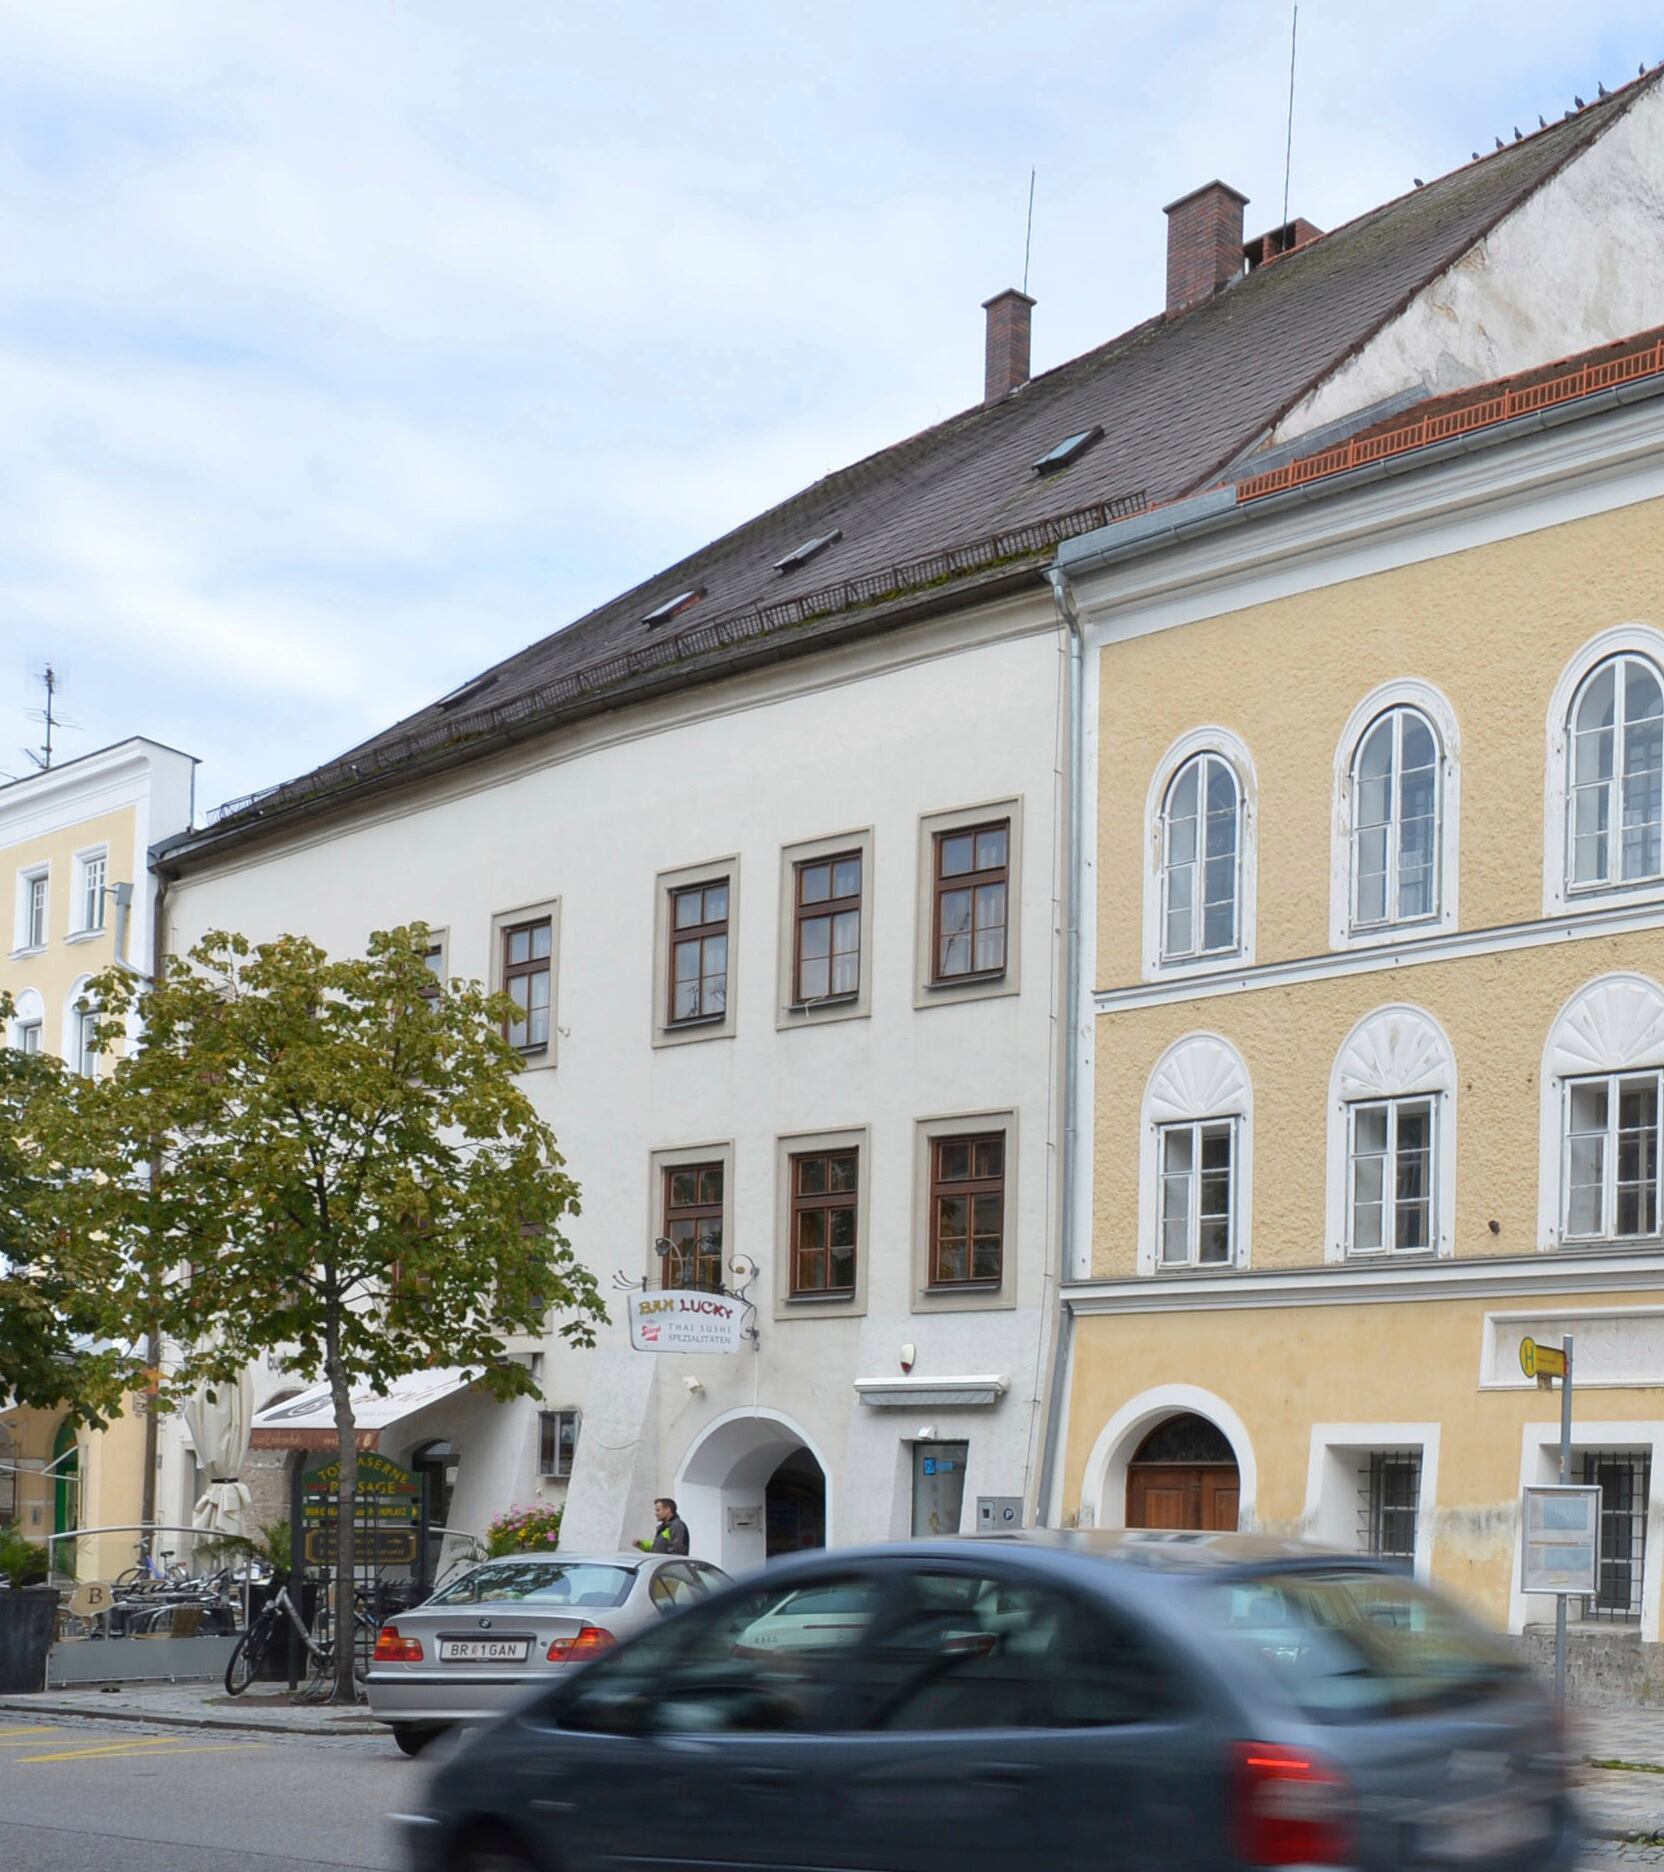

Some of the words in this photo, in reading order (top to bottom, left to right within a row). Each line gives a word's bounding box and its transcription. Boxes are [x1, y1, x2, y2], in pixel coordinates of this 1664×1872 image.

[639, 1298, 674, 1316] BAN
[679, 1298, 733, 1319] LUCKY
[668, 1323, 694, 1332] THAI
[700, 1324, 731, 1333] SUSHI
[1524, 1343, 1534, 1371] H
[329, 1480, 396, 1494] PSAGE
[88, 1587, 103, 1604] B
[451, 1644, 468, 1655] BR
